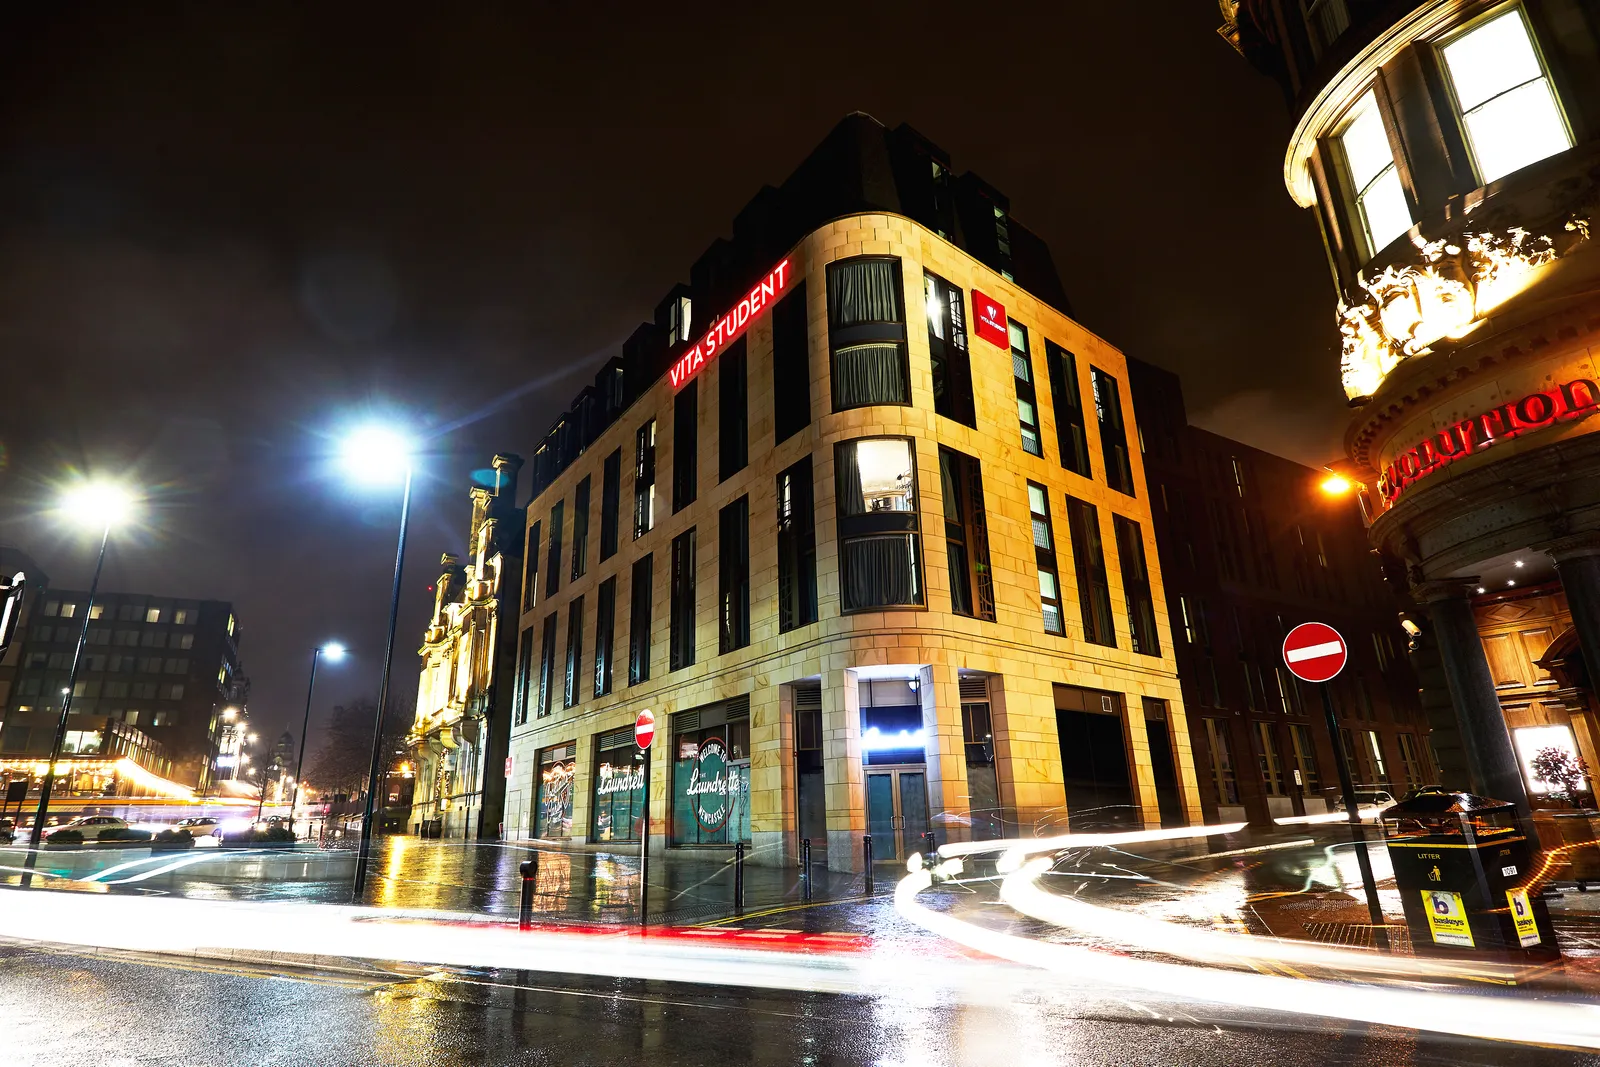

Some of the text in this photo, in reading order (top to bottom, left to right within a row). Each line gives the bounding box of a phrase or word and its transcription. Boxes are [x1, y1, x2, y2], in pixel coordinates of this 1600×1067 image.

[670, 259, 788, 387] VITA STUDENT
[699, 743, 727, 763] WELCOME TO
[597, 762, 646, 795] Laundrett
[686, 767, 741, 796] Laundrette
[698, 803, 726, 825] NEWCASTLE
[1432, 896, 1449, 915] b
[1432, 916, 1465, 926] baskeys
